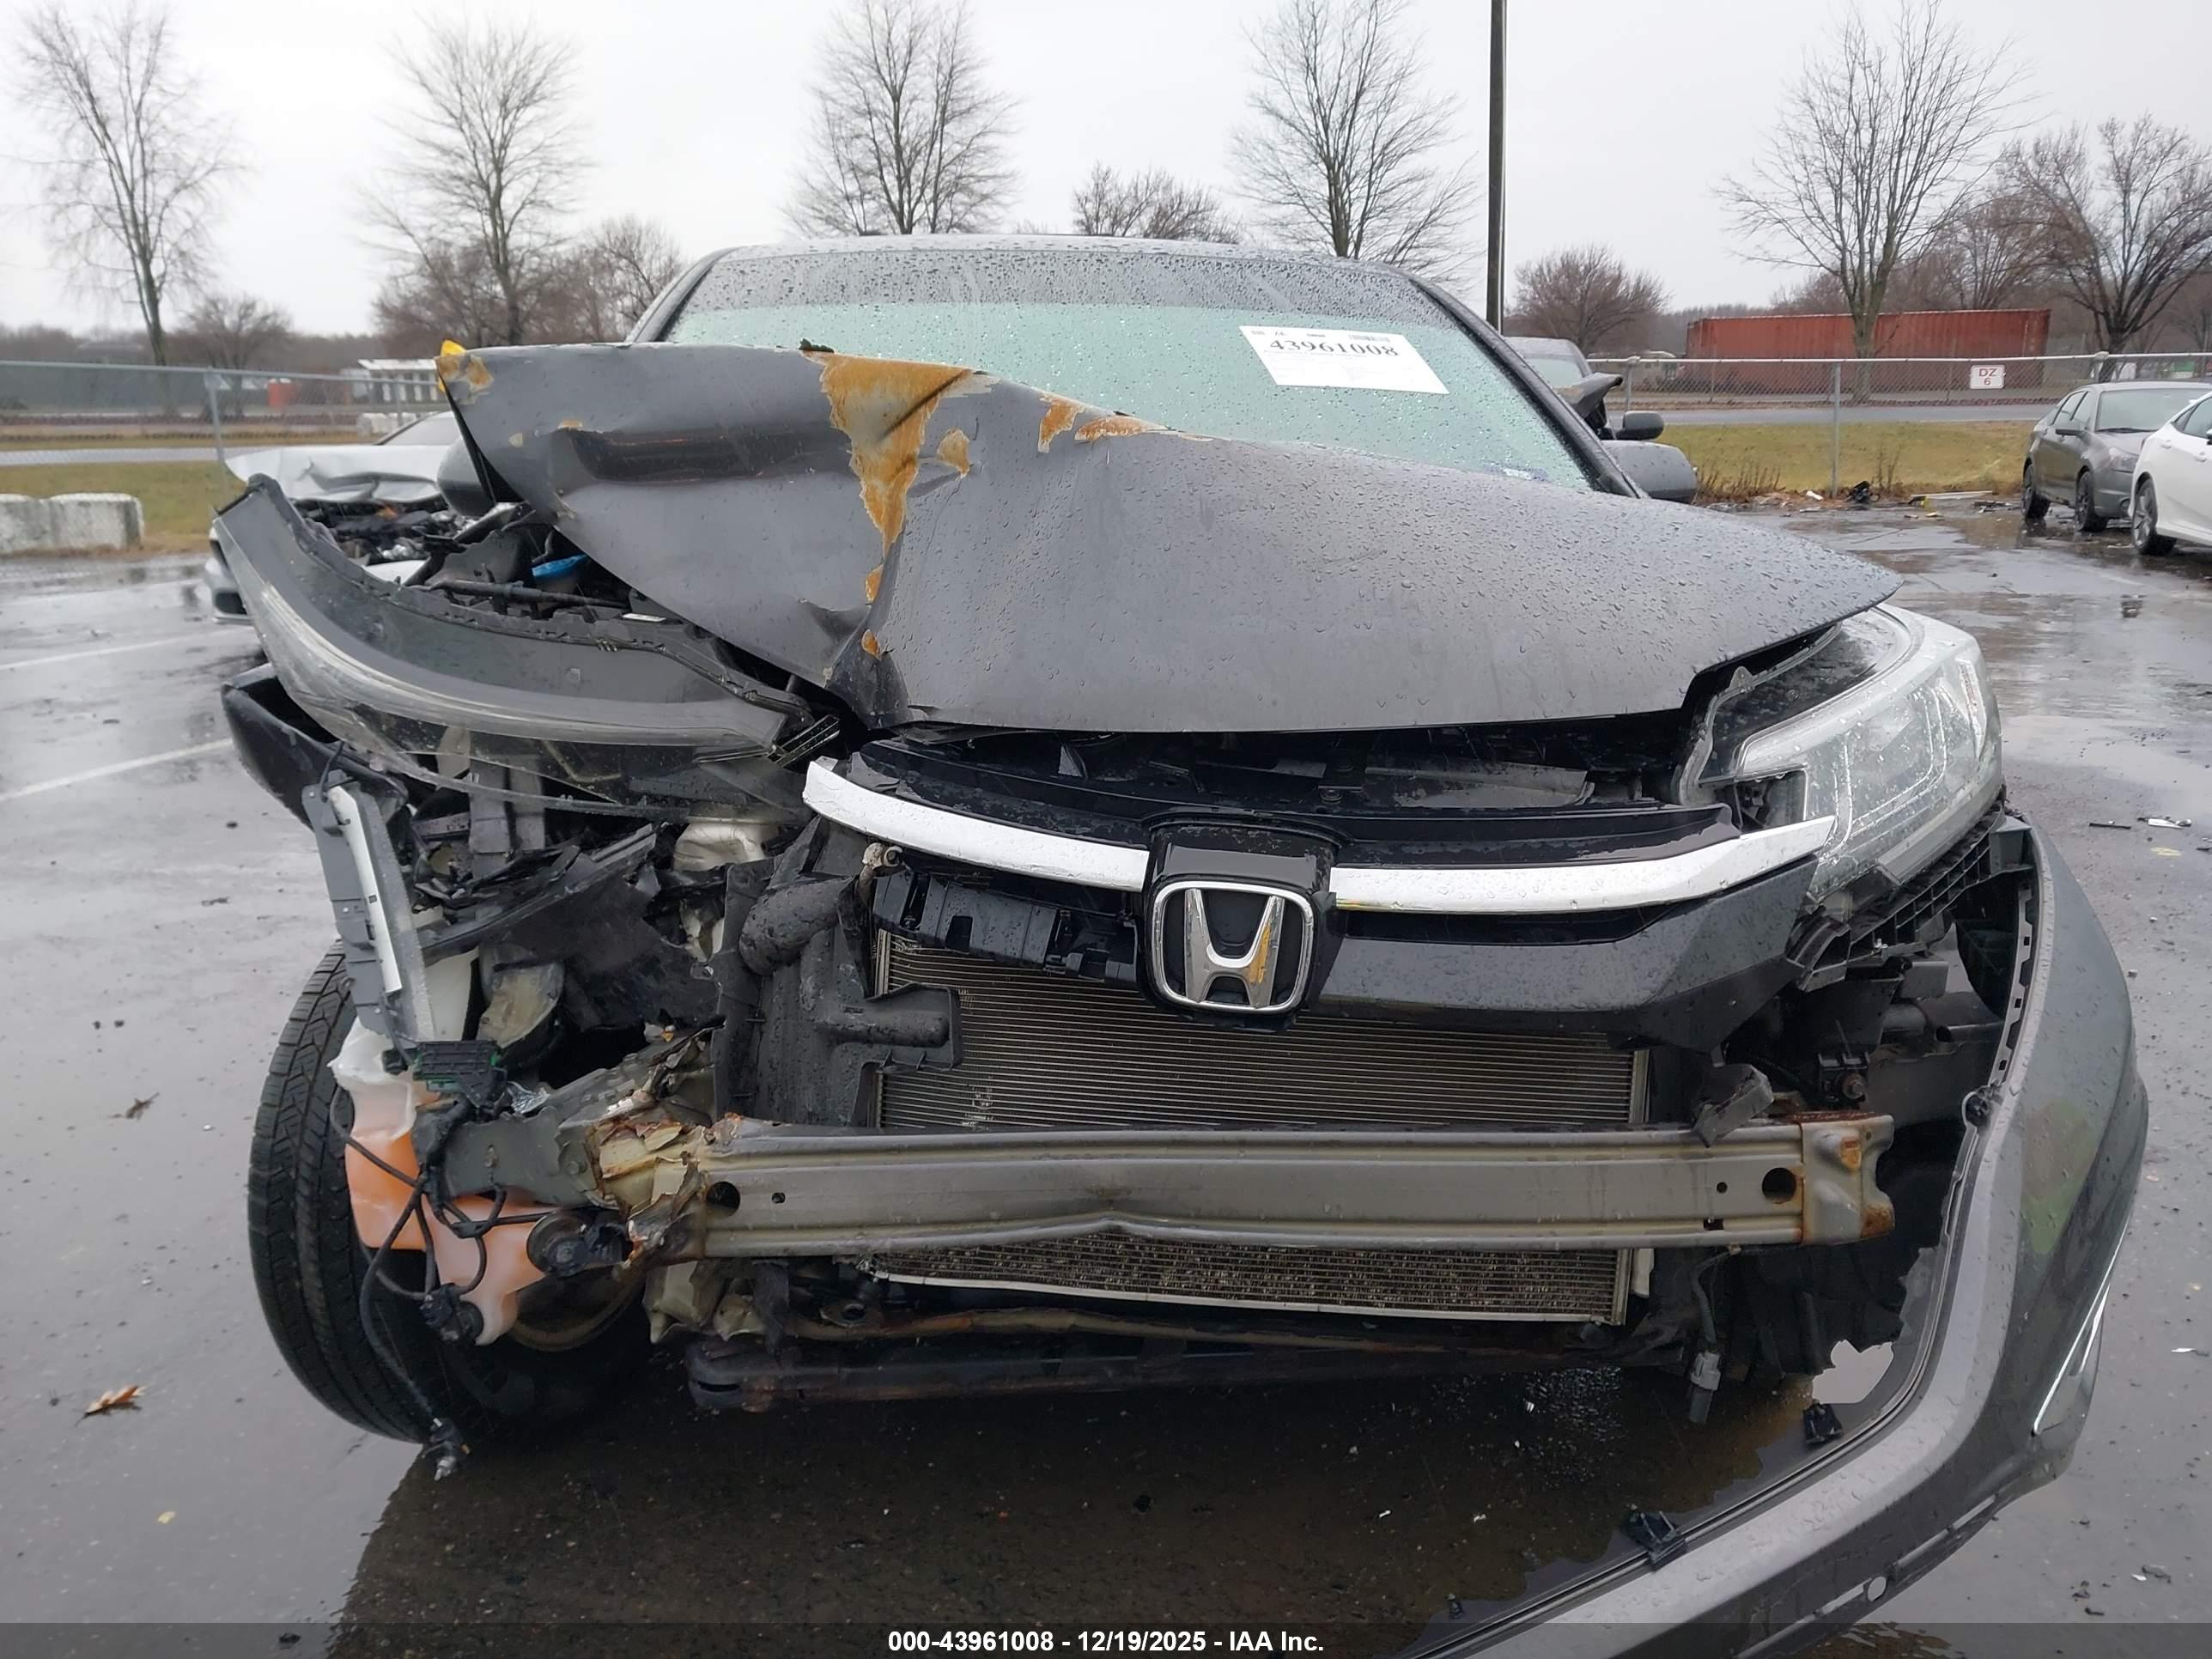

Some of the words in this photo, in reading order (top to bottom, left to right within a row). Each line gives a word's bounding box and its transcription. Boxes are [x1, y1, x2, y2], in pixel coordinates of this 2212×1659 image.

[1270, 340, 1399, 356] 43961008
[1978, 368, 1998, 377] DZ
[1984, 377, 1991, 386] 6
